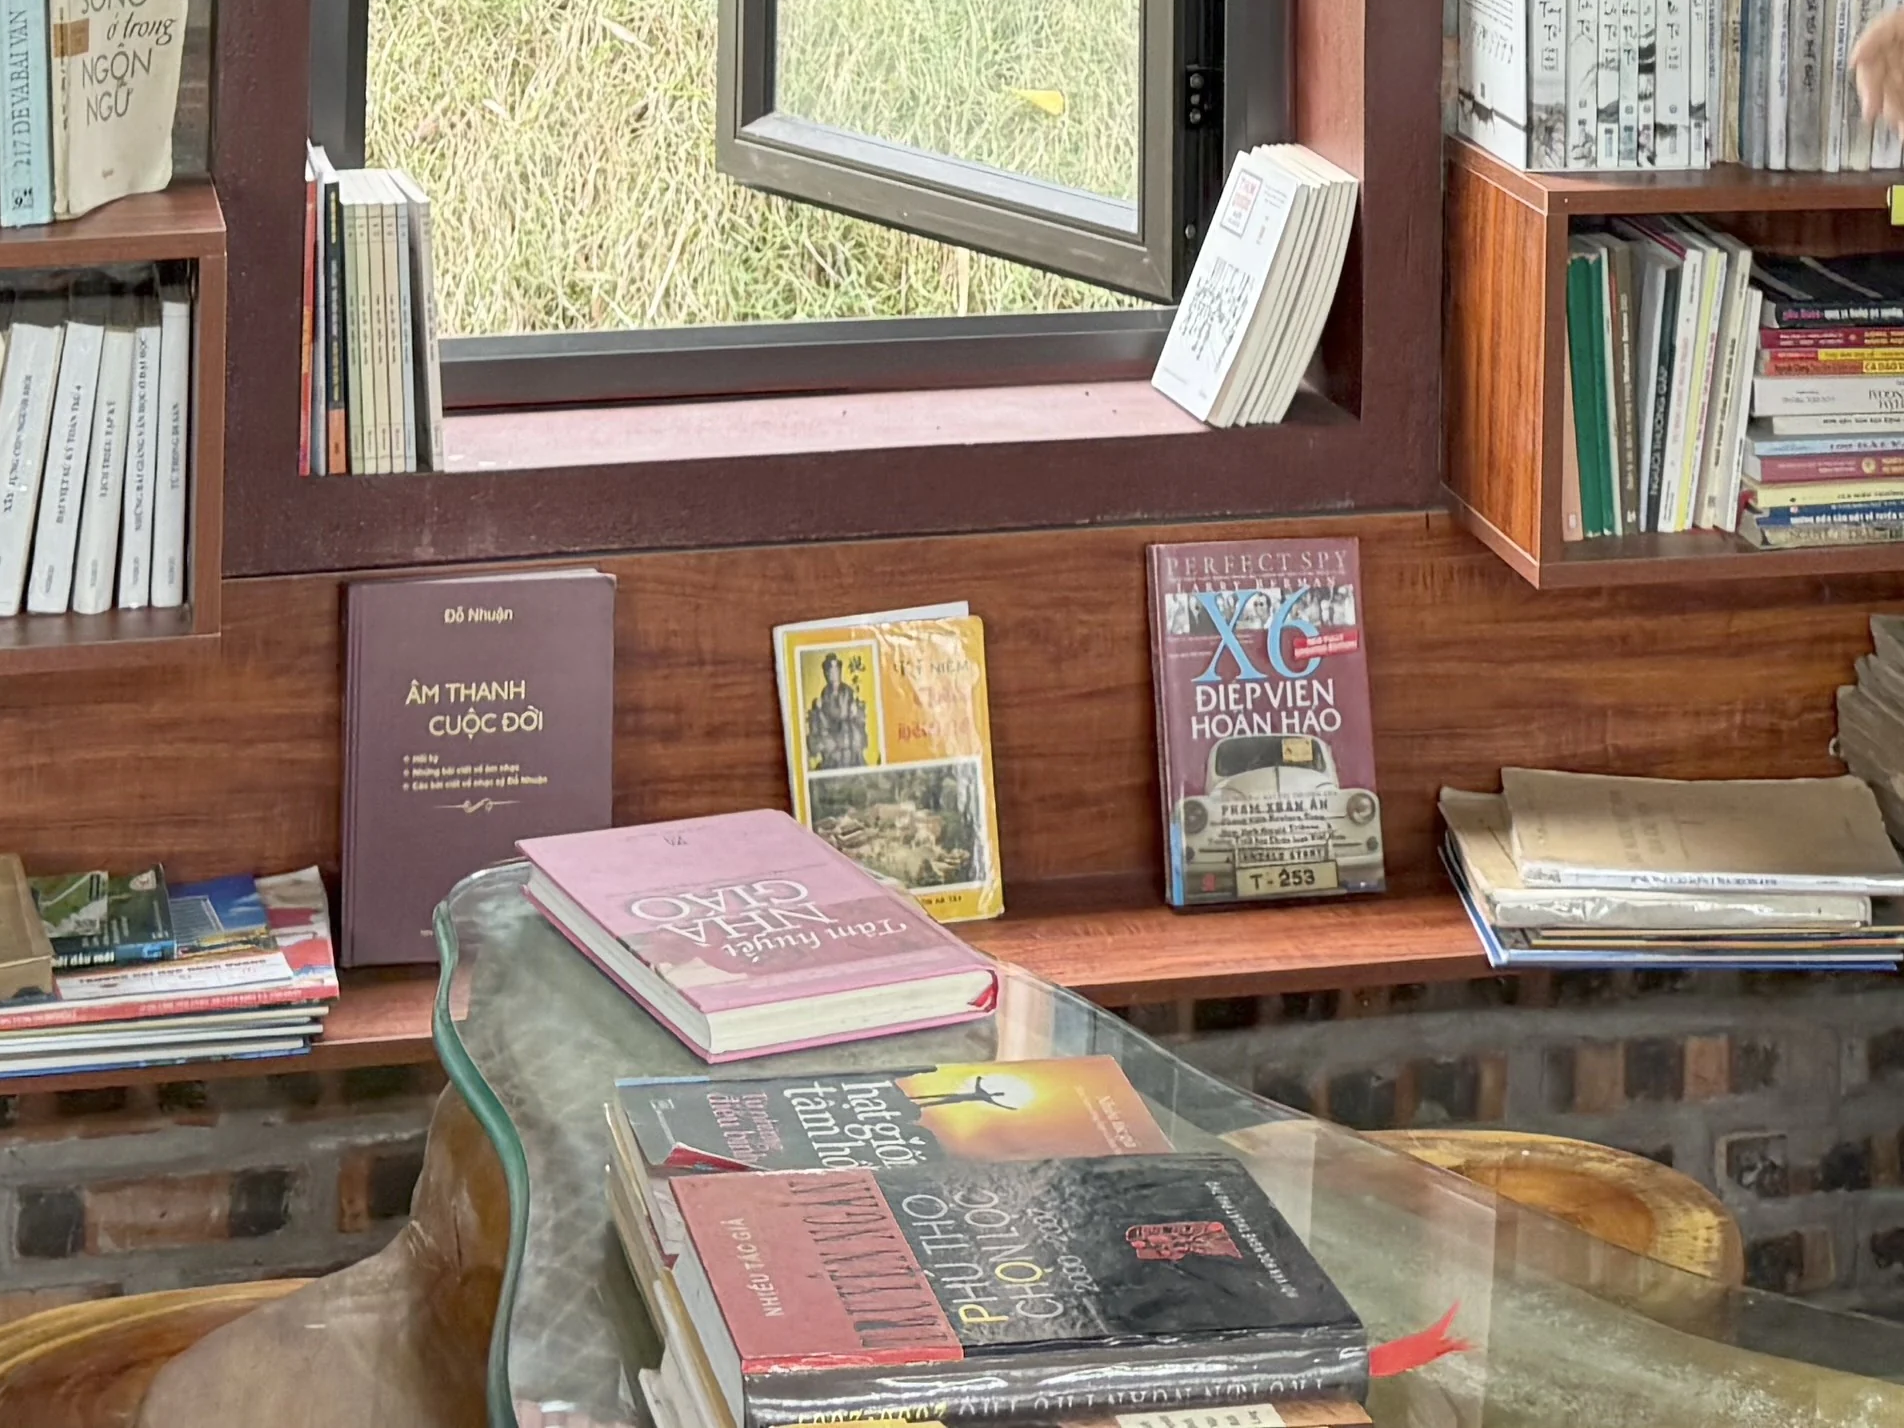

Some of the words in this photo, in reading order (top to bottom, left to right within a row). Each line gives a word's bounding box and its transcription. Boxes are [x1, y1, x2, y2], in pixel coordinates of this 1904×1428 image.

[124, 11, 175, 45] trong
[82, 43, 152, 88] NGÔN
[86, 81, 133, 126] NGỮ
[1165, 553, 1291, 576] PERFECT
[1301, 550, 1347, 568] SPY
[444, 606, 463, 624] Đỗ
[468, 606, 513, 624] Nhuận
[1191, 585, 1323, 682] X6
[405, 679, 439, 705] ÂM
[445, 680, 525, 703] THANH
[1196, 680, 1261, 714] ĐIỆP
[429, 707, 496, 739] CUỘC
[502, 705, 543, 732] ĐỜI
[631, 879, 808, 921] GIÁO
[658, 902, 839, 948] NHÀ
[825, 918, 907, 940] Tâm
[721, 930, 821, 963] huyết
[842, 1080, 901, 1121] hạt
[784, 1081, 840, 1138] tâm
[813, 1141, 881, 1169] hồ
[902, 1194, 969, 1255] THỌ
[953, 1190, 1019, 1241] LỌC
[736, 1242, 762, 1270] TÁC
[923, 1262, 1009, 1326] PHÚ
[989, 1243, 1064, 1318] CHỌN
